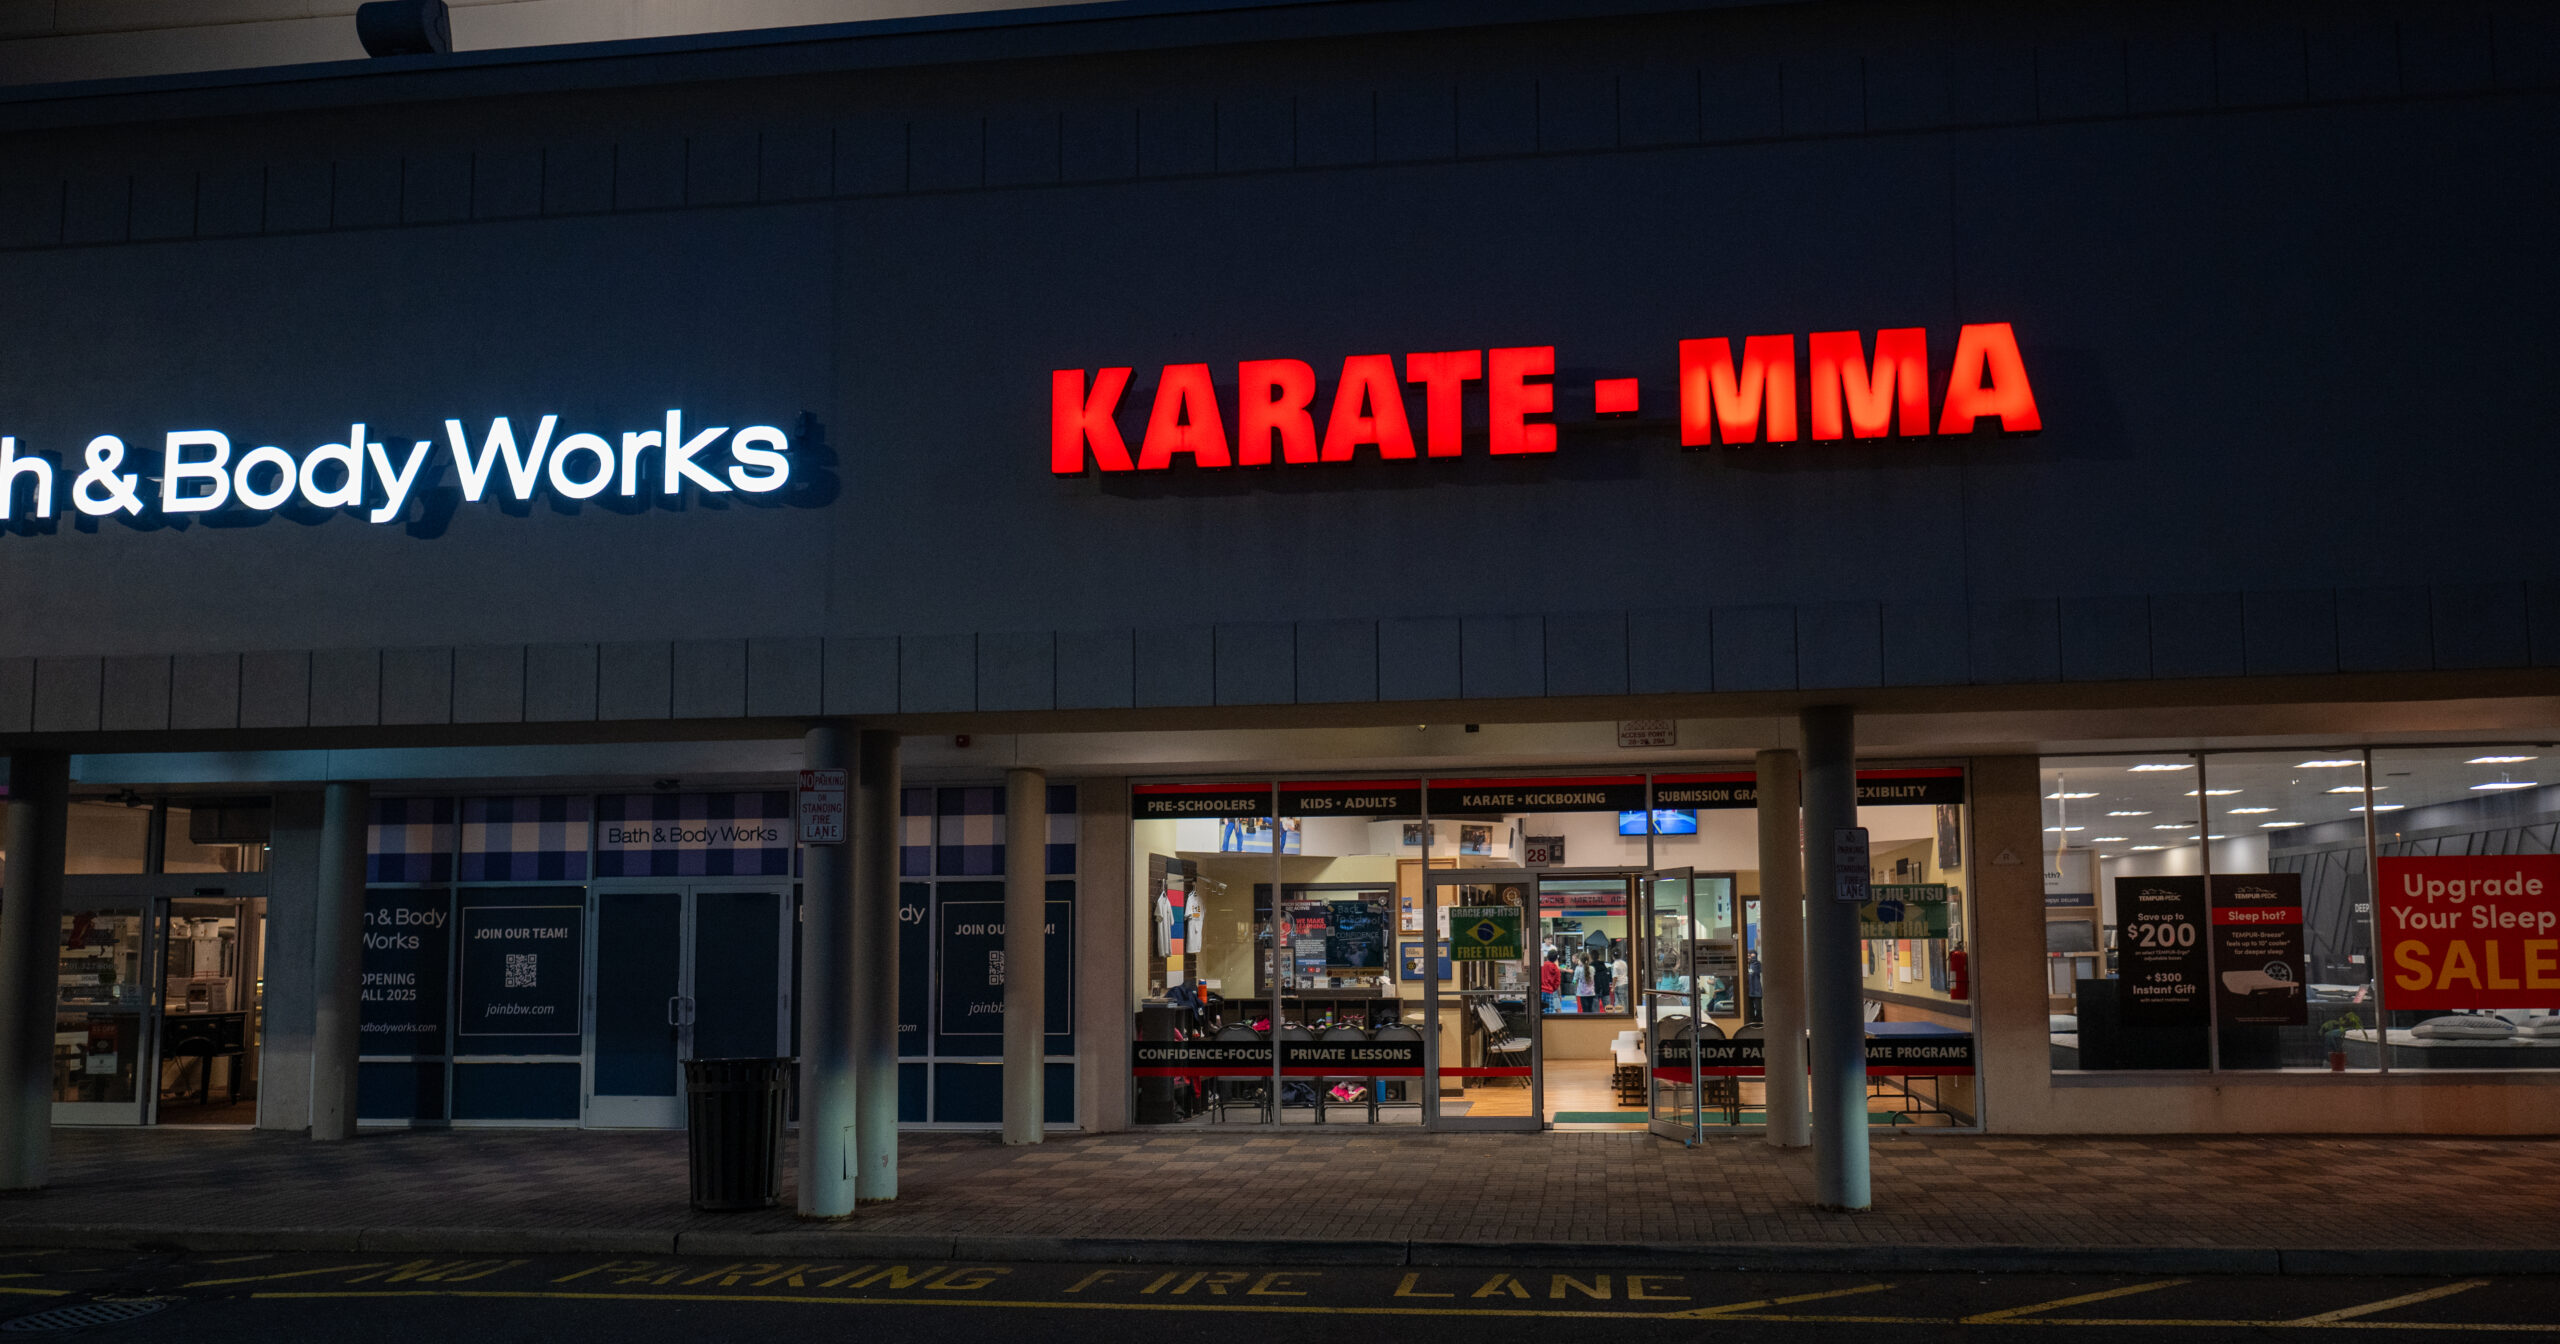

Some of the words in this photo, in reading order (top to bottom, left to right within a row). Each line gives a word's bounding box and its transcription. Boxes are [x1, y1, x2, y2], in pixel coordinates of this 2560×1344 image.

[1051, 345, 1558, 475] KARATE
[1679, 322, 2043, 449] MMA
[72, 434, 144, 517] &
[162, 424, 431, 523] Body
[445, 409, 790, 503] Works
[800, 774, 814, 787] NO
[815, 776, 844, 786] PARKING
[1657, 789, 1729, 803] SUBMISSION
[1734, 789, 1757, 801] GRA
[1856, 786, 1928, 798] EXIBILITY
[1148, 799, 1256, 812] PRE-SCHOOLERS
[1300, 797, 1333, 810] KIDS
[1344, 796, 1398, 809] ADULTS
[1462, 794, 1515, 807] KARATE
[1525, 792, 1606, 806] KICKBOXING
[802, 803, 842, 813] STANDING
[812, 814, 831, 825] FIRE
[609, 828, 650, 843] Bath
[653, 828, 667, 843] &
[670, 827, 718, 845] Body
[720, 826, 778, 842] Works
[807, 825, 838, 838] LANE
[1527, 849, 1547, 863] 28
[1836, 865, 1867, 873] STANDING
[1840, 883, 1864, 897] LANE
[2403, 871, 2544, 904] Upgrade
[377, 908, 392, 926] &
[395, 907, 447, 929] Body
[1451, 908, 1480, 918] GRACIE
[2138, 913, 2160, 921] Save
[2161, 914, 2174, 922] up
[2175, 912, 2185, 920] to
[2228, 911, 2259, 923] Sleep
[2261, 910, 2287, 920] hot?
[2390, 906, 2462, 930] Your
[2471, 904, 2557, 936] Sleep
[474, 928, 502, 940] JOIN
[505, 928, 530, 940] OUR
[532, 927, 569, 940] TEAM!
[955, 924, 984, 936] JOIN
[987, 923, 1005, 935] OU
[1860, 920, 1884, 937] REE
[2127, 922, 2197, 948] $200
[1457, 946, 1483, 959] FREE
[1485, 945, 1515, 958] TRIAL
[2393, 939, 2560, 991] SALE
[2154, 972, 2183, 982] $300
[361, 988, 384, 1001] ALL
[386, 988, 416, 1001] 2025
[2132, 985, 2172, 995] Instant
[2174, 983, 2197, 994] Gift
[484, 1003, 555, 1018] joinbbw.com
[968, 1001, 1006, 1016] joinbb
[360, 1022, 437, 1035] dbodyworks.com
[1290, 1048, 1346, 1060] PRIVATE
[1351, 1048, 1412, 1061] LESSONS
[1664, 1047, 1736, 1059] BIRHDAY
[1742, 1047, 1765, 1059] PA
[1865, 1046, 1893, 1059] RATE
[1896, 1046, 1968, 1059] PROGRAMS
[345, 1258, 533, 1283] NO
[551, 1260, 1013, 1290] PARKING
[1063, 1270, 1322, 1296] FIRE
[1394, 1272, 1691, 1301] LANE
